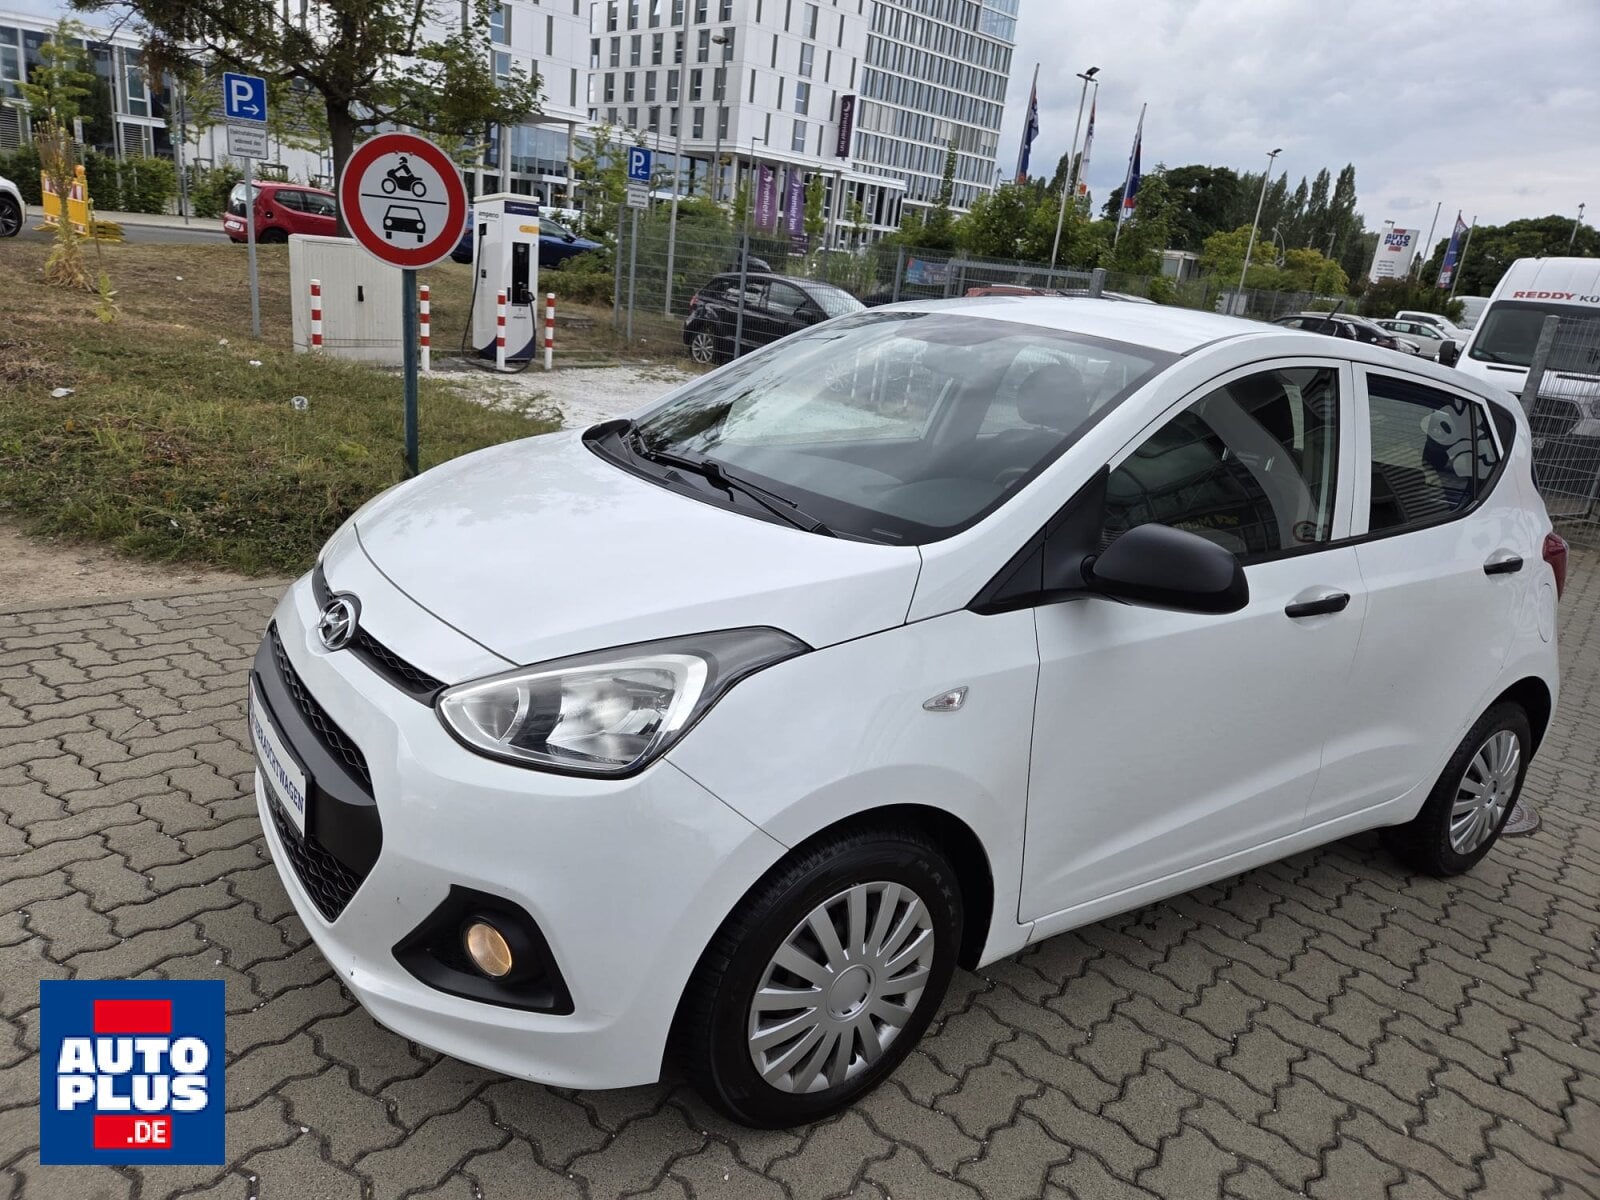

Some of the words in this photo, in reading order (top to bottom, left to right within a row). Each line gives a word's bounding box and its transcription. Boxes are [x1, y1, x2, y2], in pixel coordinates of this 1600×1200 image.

[231, 79, 254, 113] P
[631, 151, 645, 175] P
[1384, 239, 1409, 247] PLUS
[1386, 233, 1411, 241] AUTO
[1512, 291, 1576, 301] REDDY
[254, 714, 304, 815] EBRAUCHTWAGEN
